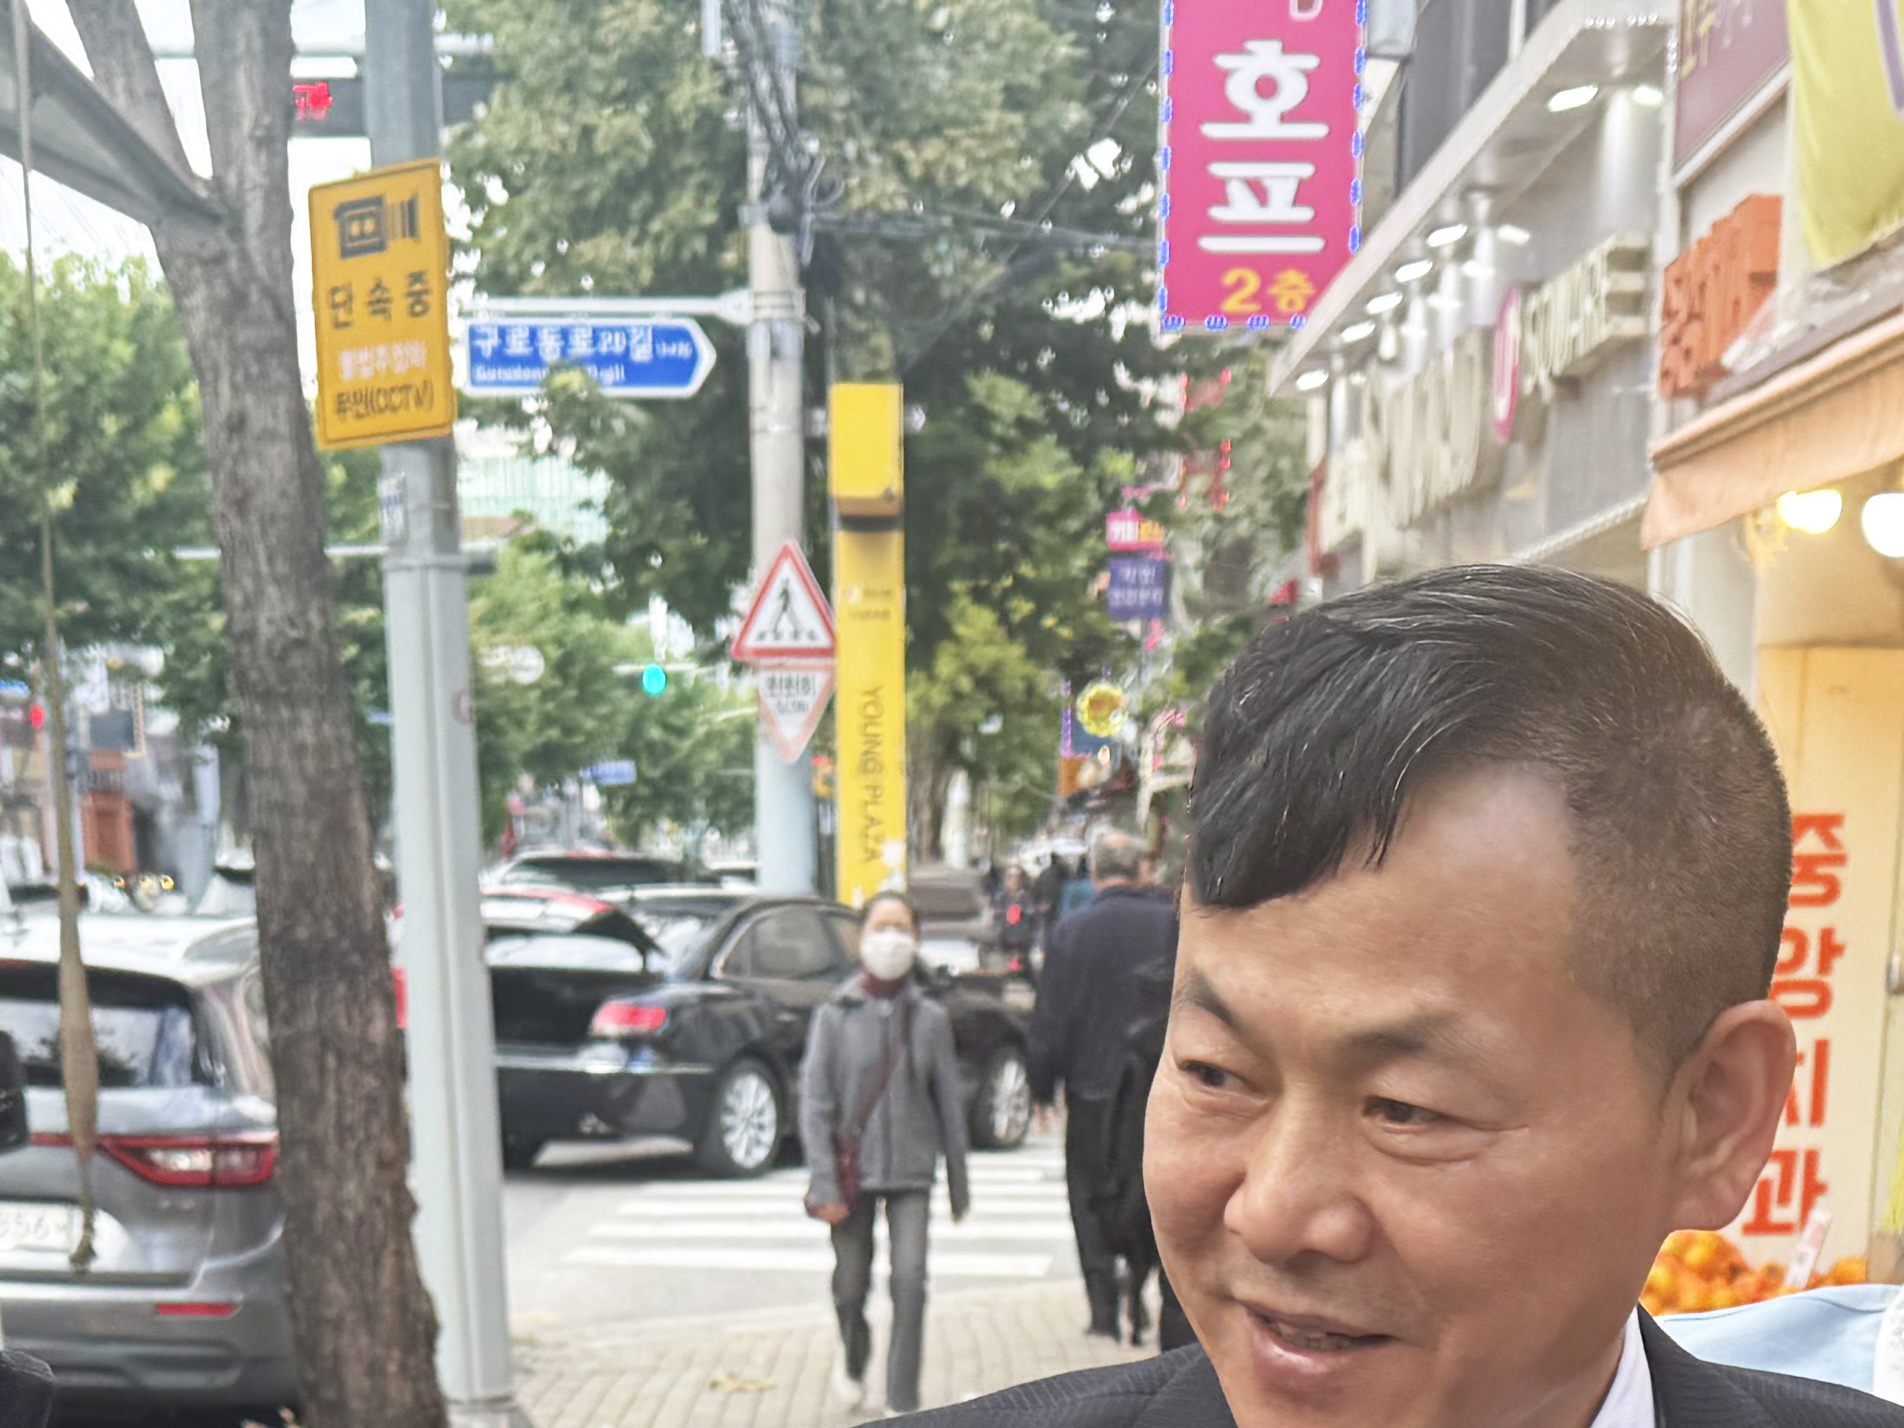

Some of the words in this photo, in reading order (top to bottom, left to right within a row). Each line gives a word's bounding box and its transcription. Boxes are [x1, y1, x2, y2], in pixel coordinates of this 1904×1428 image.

[1197, 38, 1331, 255] 호프
[329, 270, 431, 331] 단속중
[1220, 267, 1316, 315] 2층
[861, 685, 886, 776] YOUNG
[863, 784, 886, 863] PLAZA
